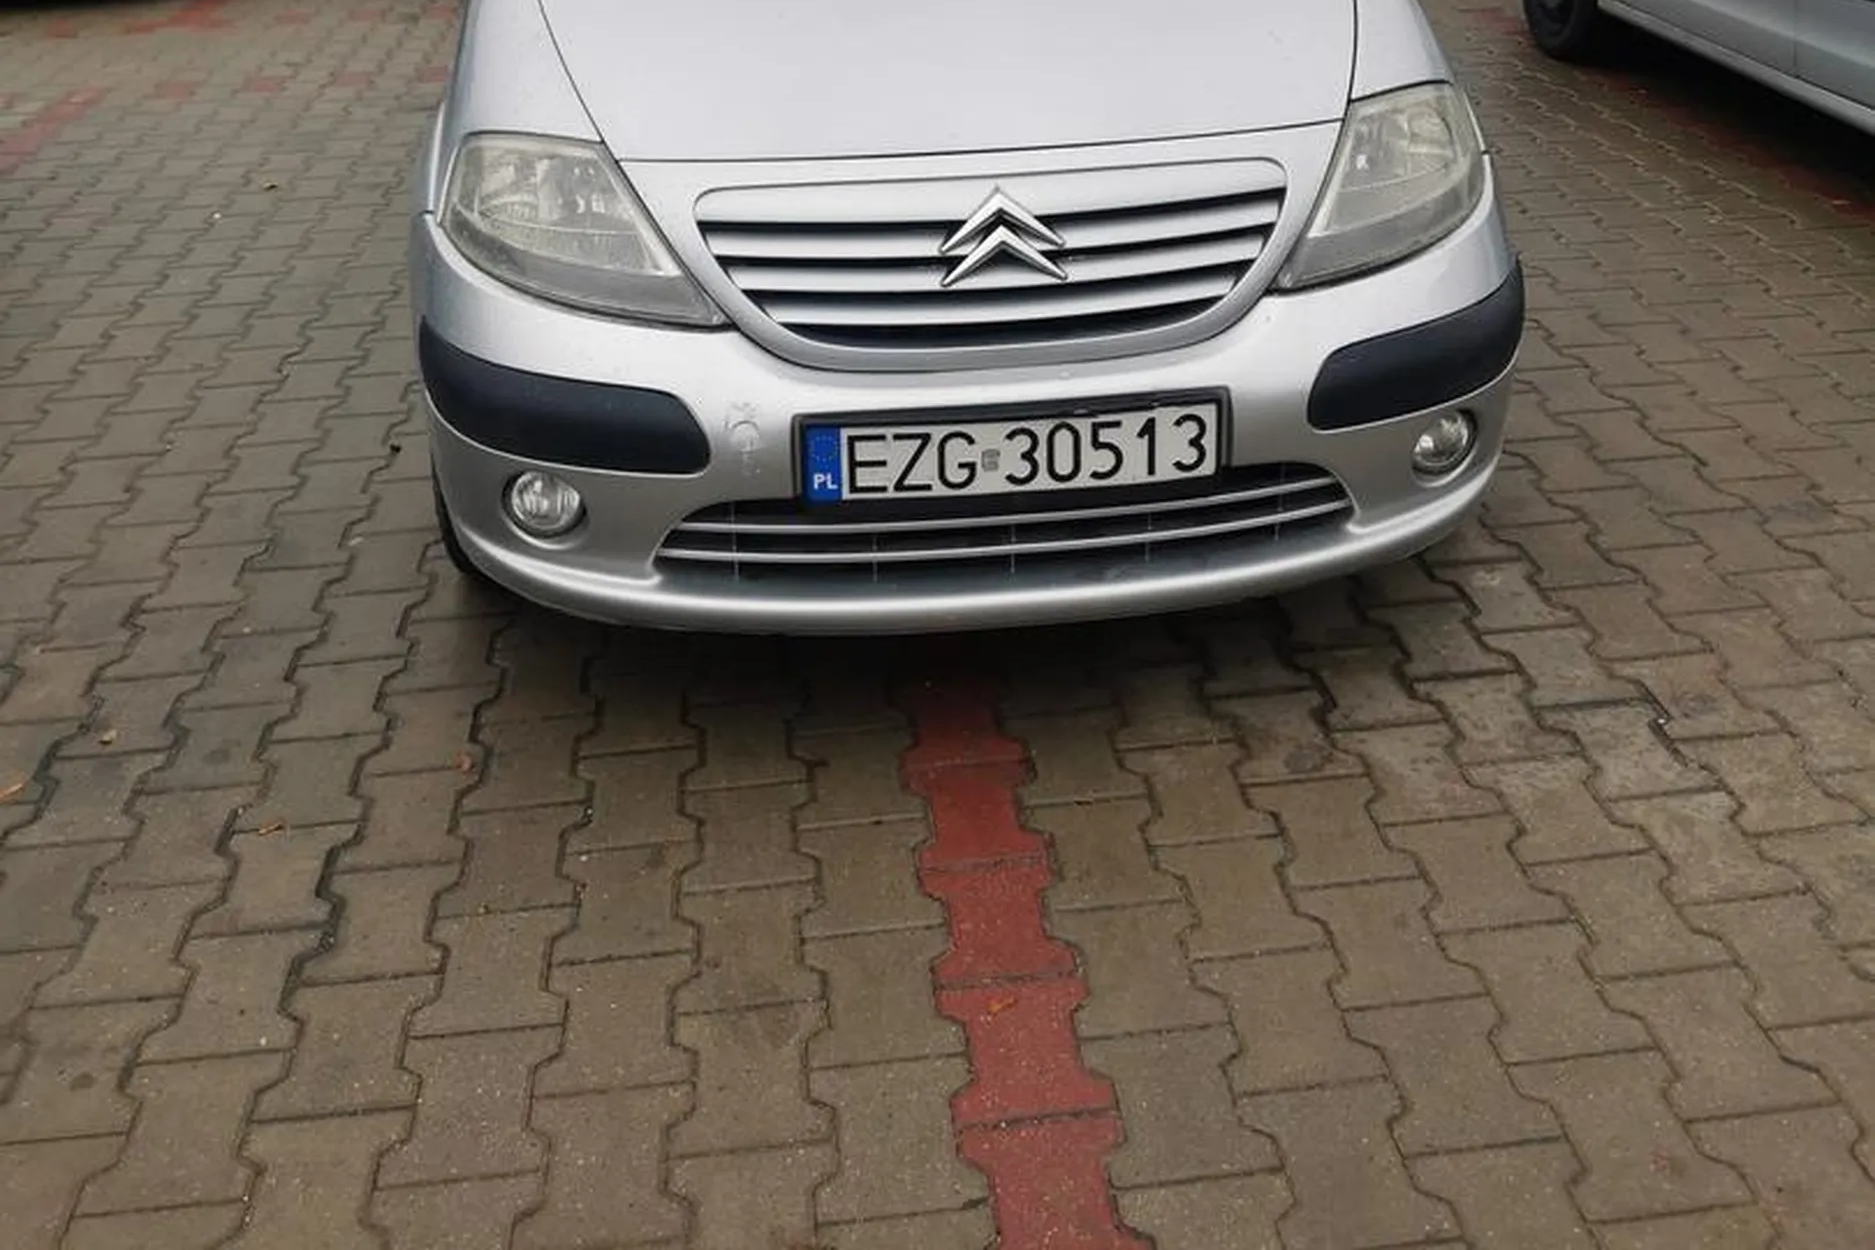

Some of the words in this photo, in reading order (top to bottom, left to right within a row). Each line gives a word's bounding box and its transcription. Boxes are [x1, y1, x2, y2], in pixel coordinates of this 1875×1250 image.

[846, 430, 977, 494] EZG
[1004, 413, 1207, 486] 30513
[813, 473, 838, 491] PL
